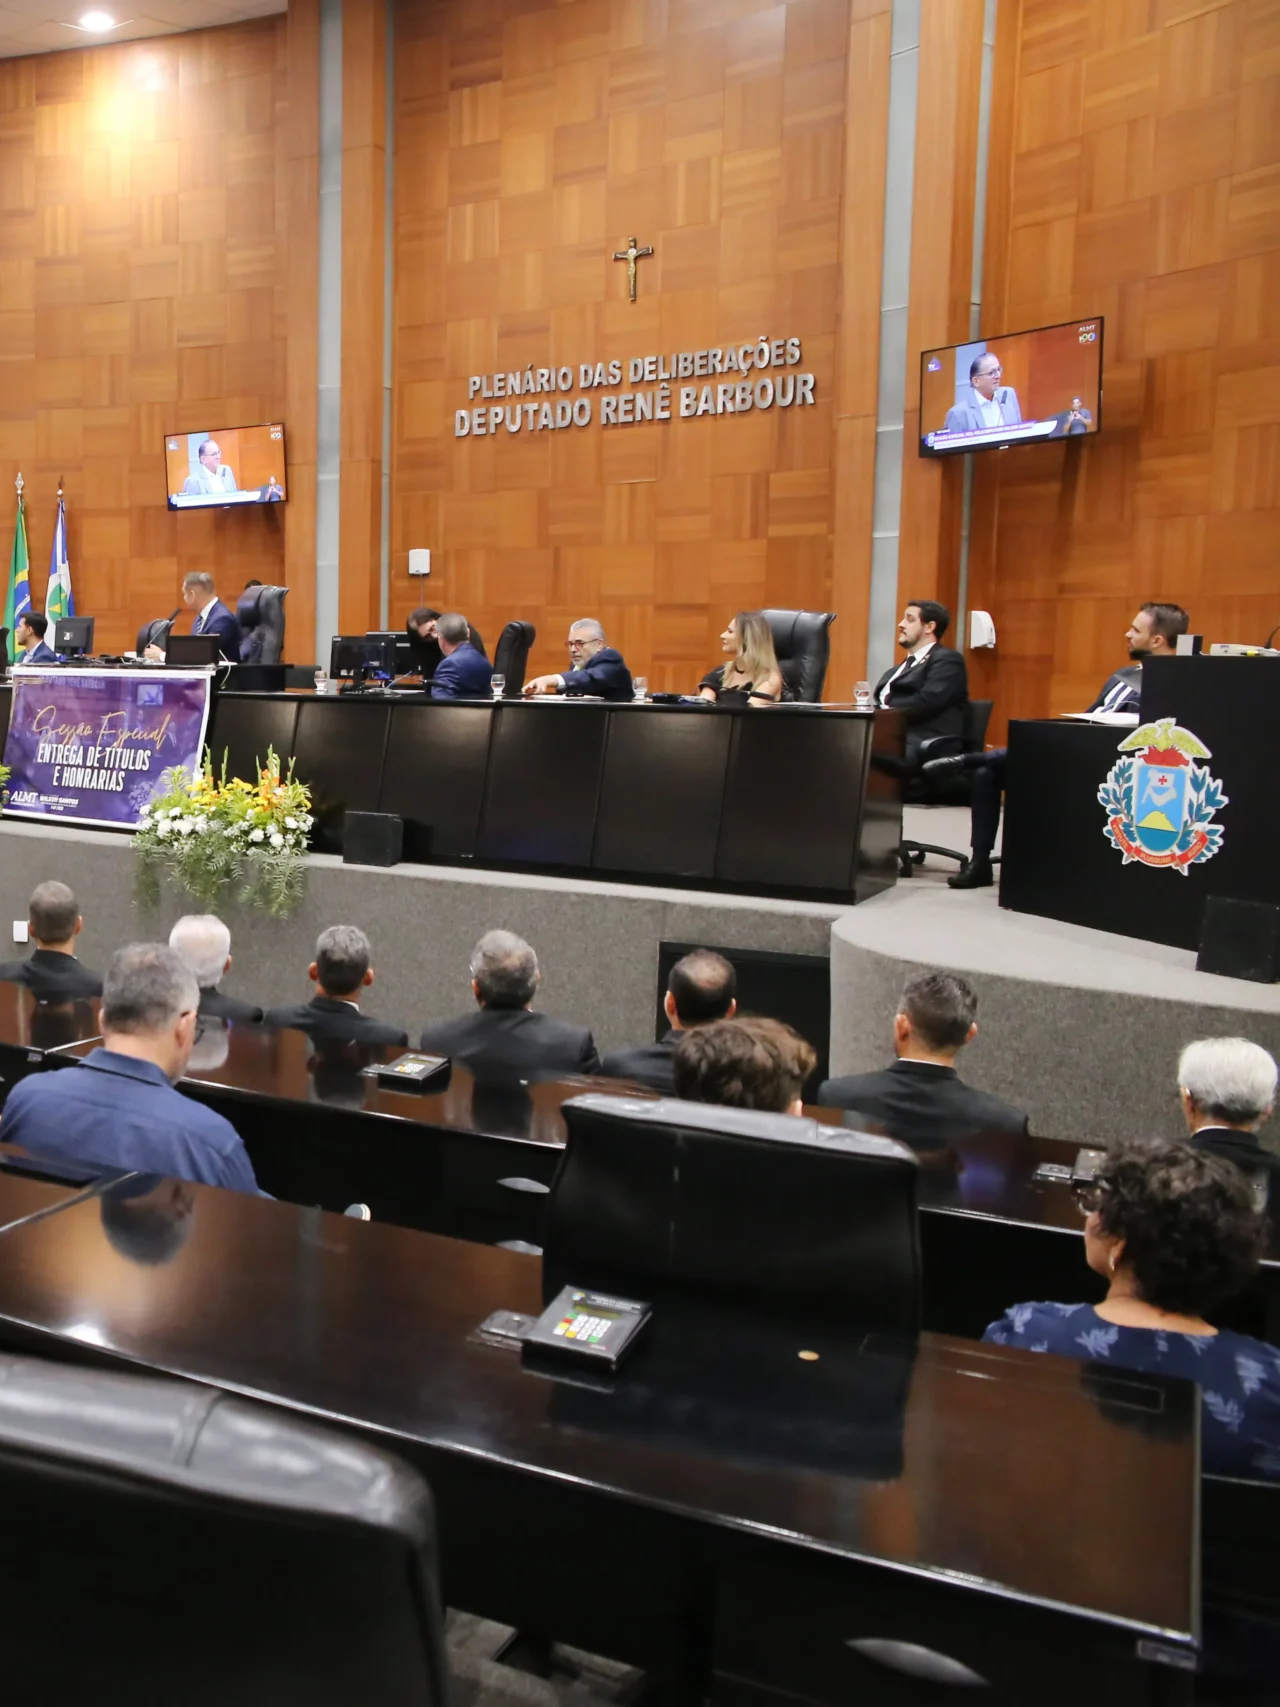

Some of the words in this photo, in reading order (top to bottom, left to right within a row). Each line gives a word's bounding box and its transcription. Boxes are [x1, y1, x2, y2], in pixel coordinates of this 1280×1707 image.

[469, 364, 574, 400] PLENÁRIO
[579, 359, 623, 389] DAS
[629, 336, 802, 384] DELIBERAÇÕES
[454, 397, 592, 438] DEPUTADO
[600, 382, 672, 426] RENÊ
[680, 372, 816, 418] BARBOUR
[37, 743, 84, 767] ENTREGA
[86, 746, 103, 767] DE
[53, 766, 62, 786] E
[62, 766, 126, 792] HONRARIAS
[10, 790, 39, 804] ALMT
